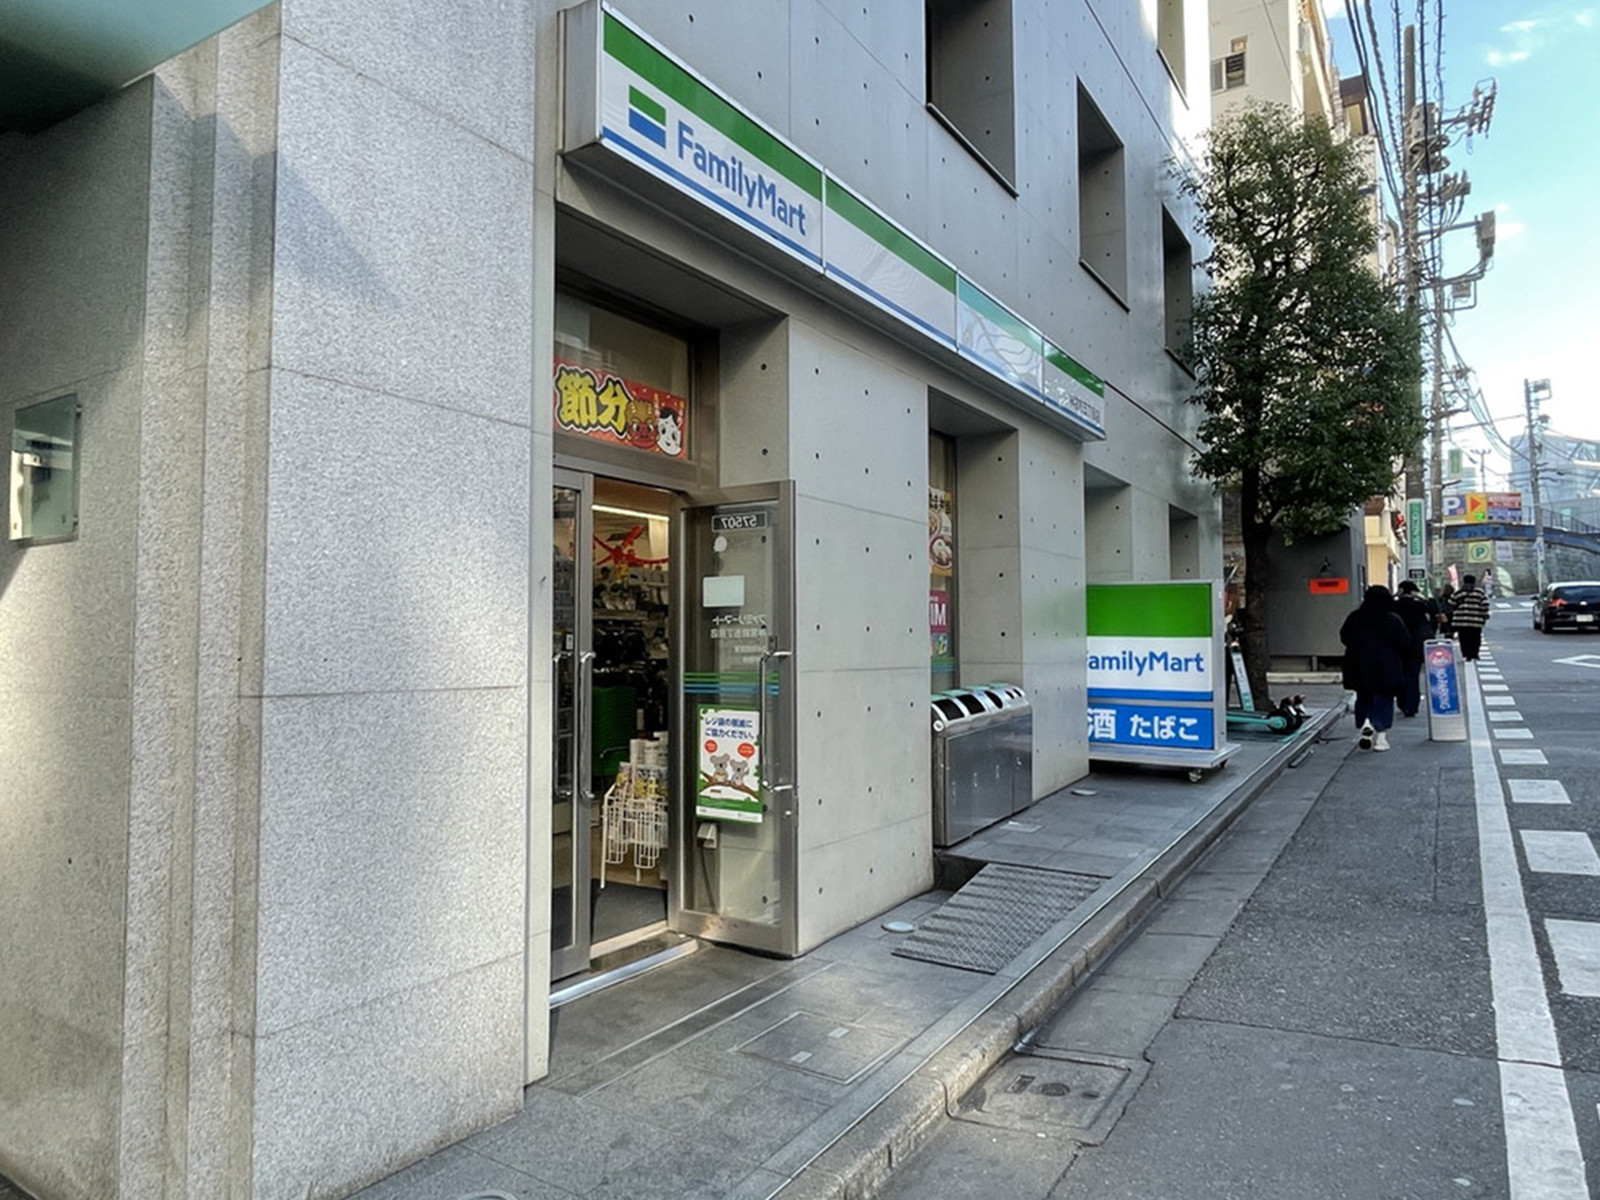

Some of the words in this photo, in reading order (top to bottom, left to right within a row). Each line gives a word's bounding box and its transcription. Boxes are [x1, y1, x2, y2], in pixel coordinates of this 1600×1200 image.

[678, 120, 806, 236] FamilyMart
[556, 368, 630, 434] 節分
[1443, 496, 1461, 515] P
[1087, 651, 1204, 676] amilyMart
[1087, 708, 1117, 739] 酒
[1130, 714, 1199, 740] たばこ
